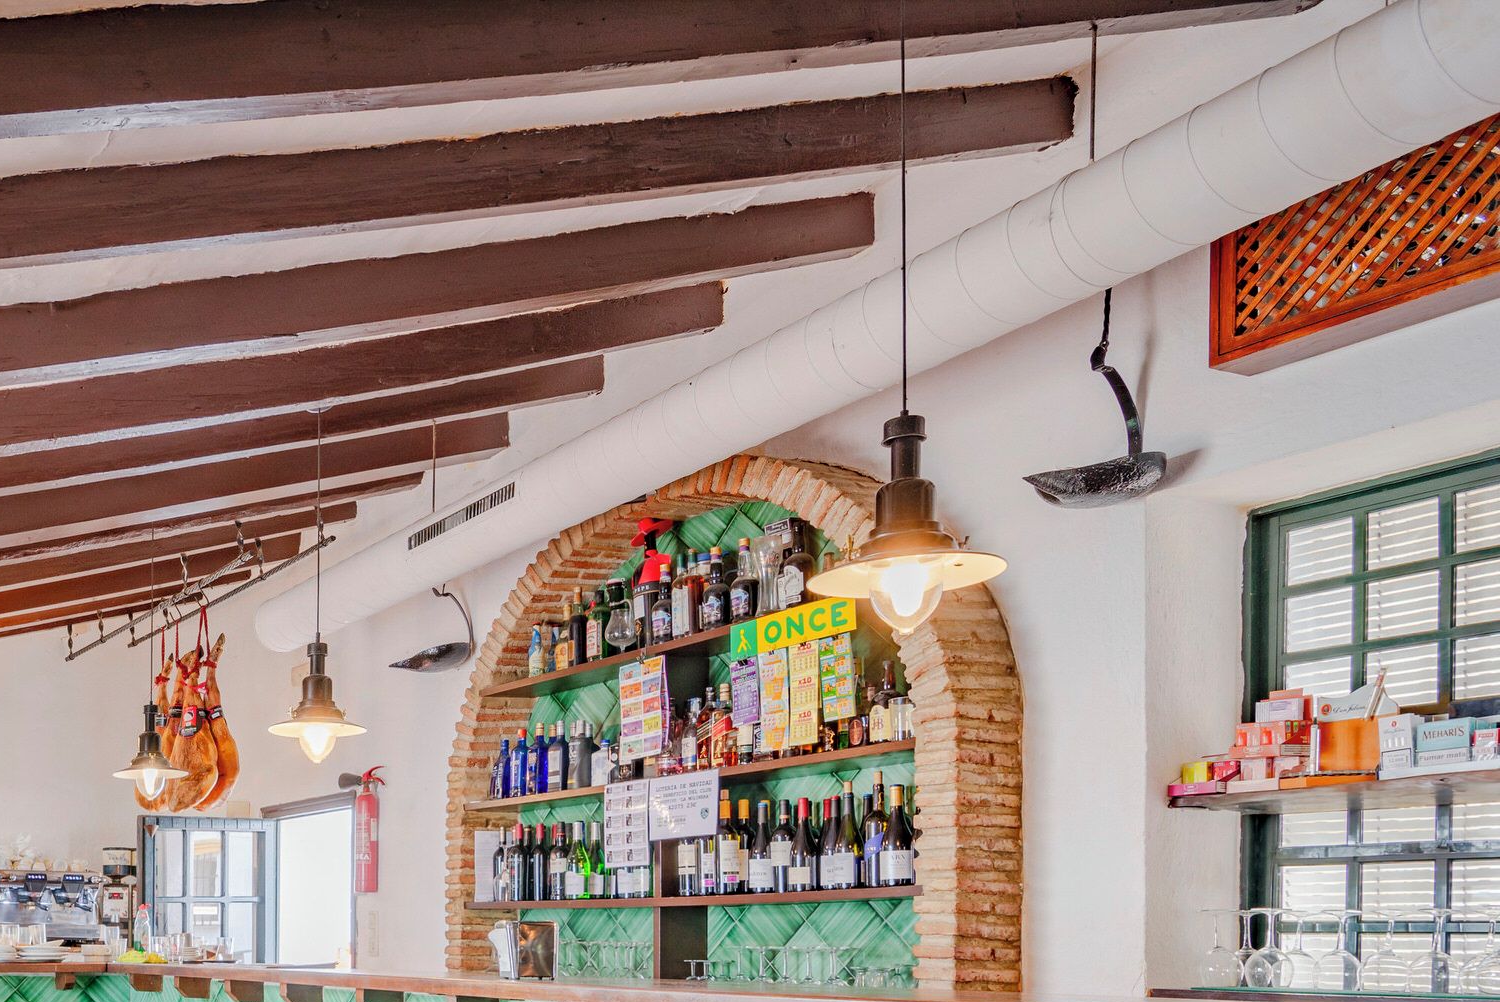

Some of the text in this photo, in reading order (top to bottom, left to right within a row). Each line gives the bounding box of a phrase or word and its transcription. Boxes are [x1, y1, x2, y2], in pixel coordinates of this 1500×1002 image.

[763, 601, 849, 644] ONCE
[1422, 726, 1465, 742] MEHARI'S
[1419, 752, 1467, 763] Fumar mata
[689, 780, 713, 788] NAVIDAD
